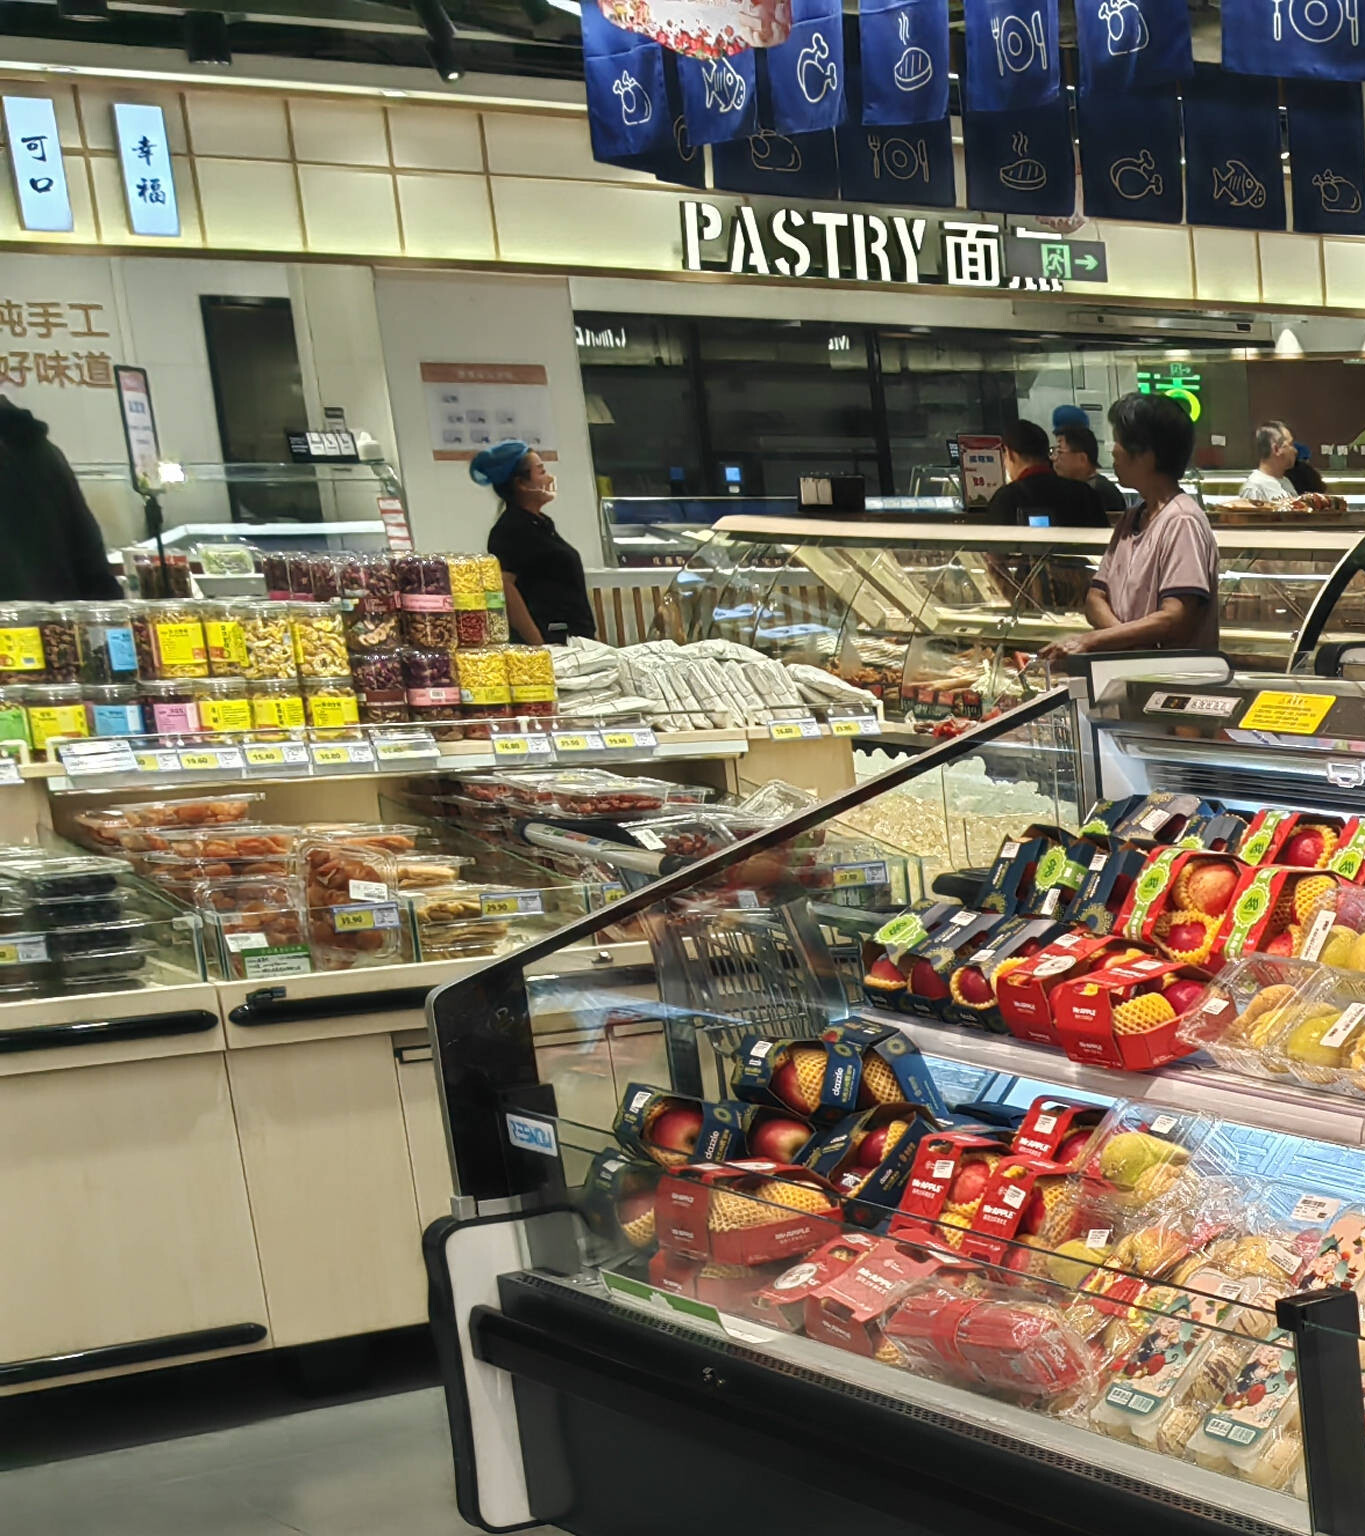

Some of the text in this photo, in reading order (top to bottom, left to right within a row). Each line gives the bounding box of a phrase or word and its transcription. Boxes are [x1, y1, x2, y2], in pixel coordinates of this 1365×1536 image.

[20, 134, 54, 195] 可口
[131, 135, 166, 206] 幸福
[679, 200, 927, 284] PASTRY
[1018, 1136, 1052, 1152] MrAPPLE
[911, 1178, 944, 1194] MrAPPLE
[982, 1204, 1016, 1220] MrAPPLE
